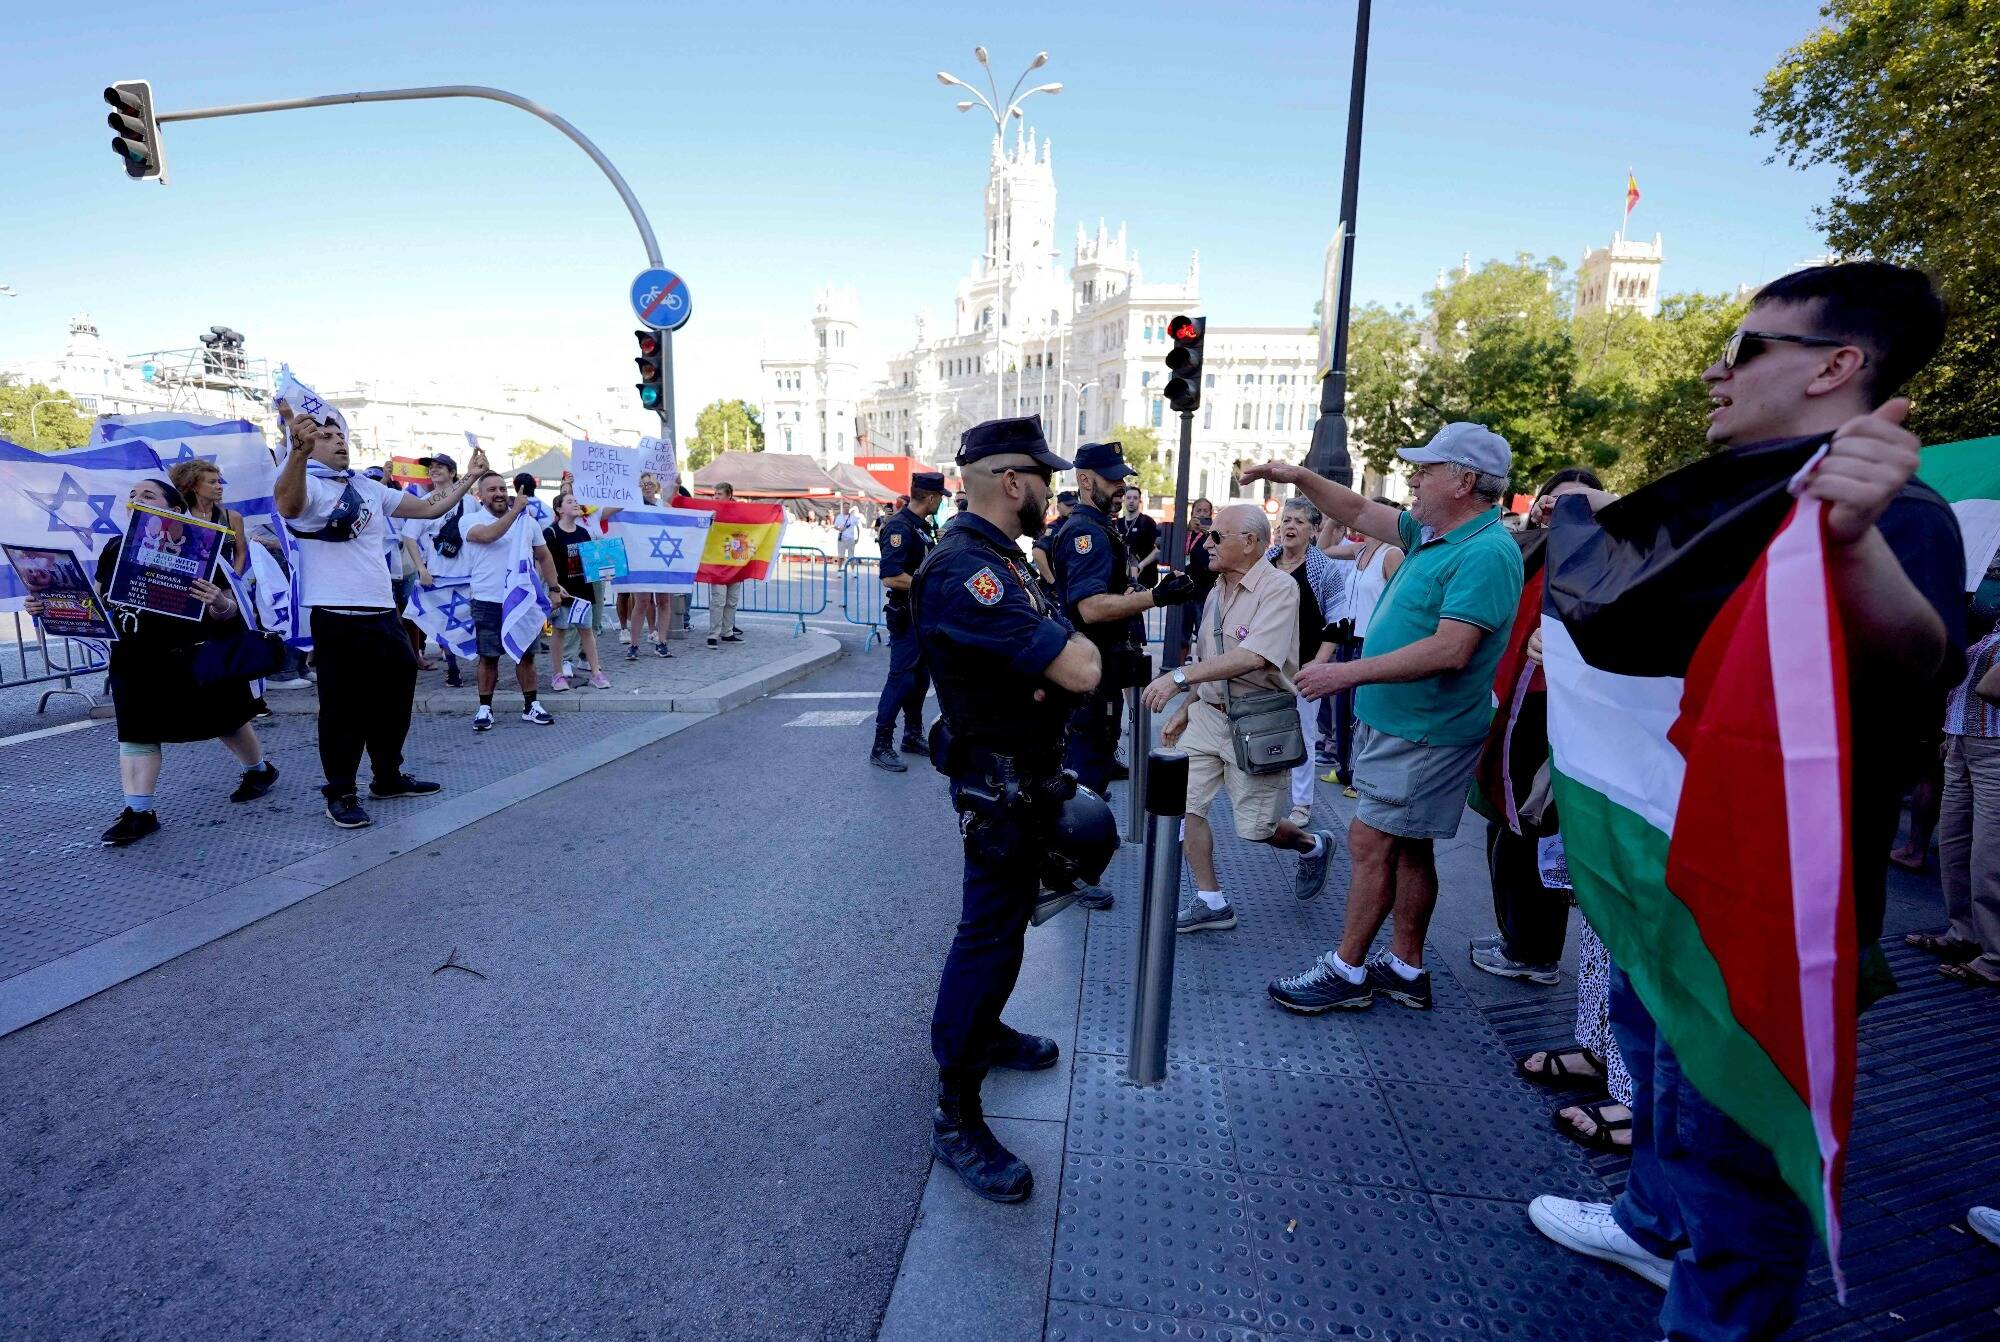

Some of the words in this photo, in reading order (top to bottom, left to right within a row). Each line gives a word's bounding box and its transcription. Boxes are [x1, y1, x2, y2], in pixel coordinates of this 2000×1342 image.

[588, 446, 605, 459] POR
[608, 449, 622, 461] EL
[582, 461, 630, 477] DEPORTE
[595, 473, 614, 487] SIN
[428, 490, 448, 506] LOVE
[579, 484, 633, 501] VIOLENCIA
[353, 509, 369, 532] FILA
[174, 556, 197, 568] WITH
[147, 578, 188, 591] PREMIAMOS
[156, 573, 181, 584] ESPAÑA
[49, 600, 76, 609] KFIR
